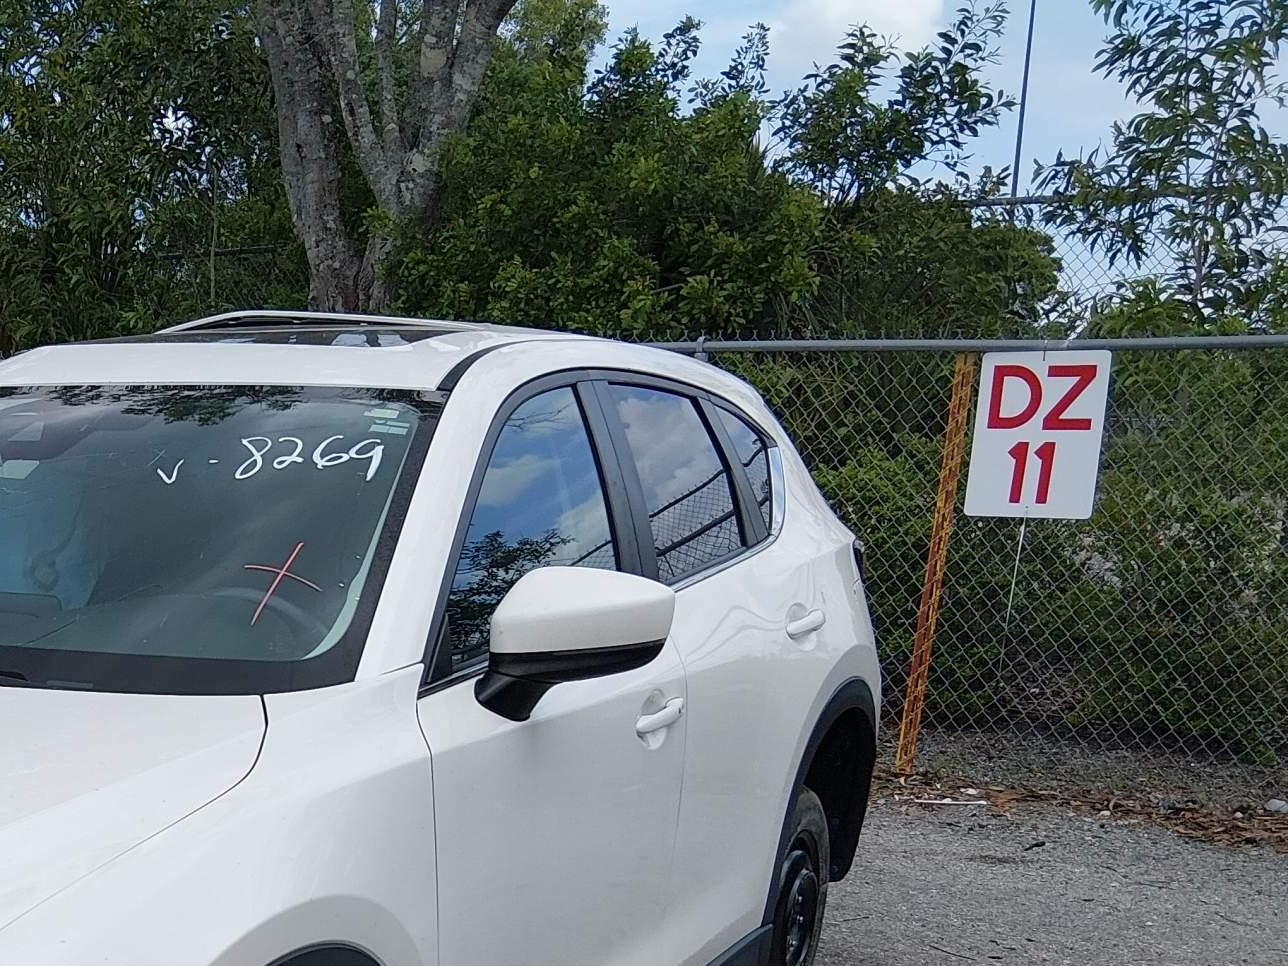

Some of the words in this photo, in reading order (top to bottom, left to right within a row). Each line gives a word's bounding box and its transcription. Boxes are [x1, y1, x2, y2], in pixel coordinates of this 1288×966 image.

[986, 364, 1098, 431] DZ
[233, 434, 385, 482] 8269
[1007, 441, 1057, 504] 11
